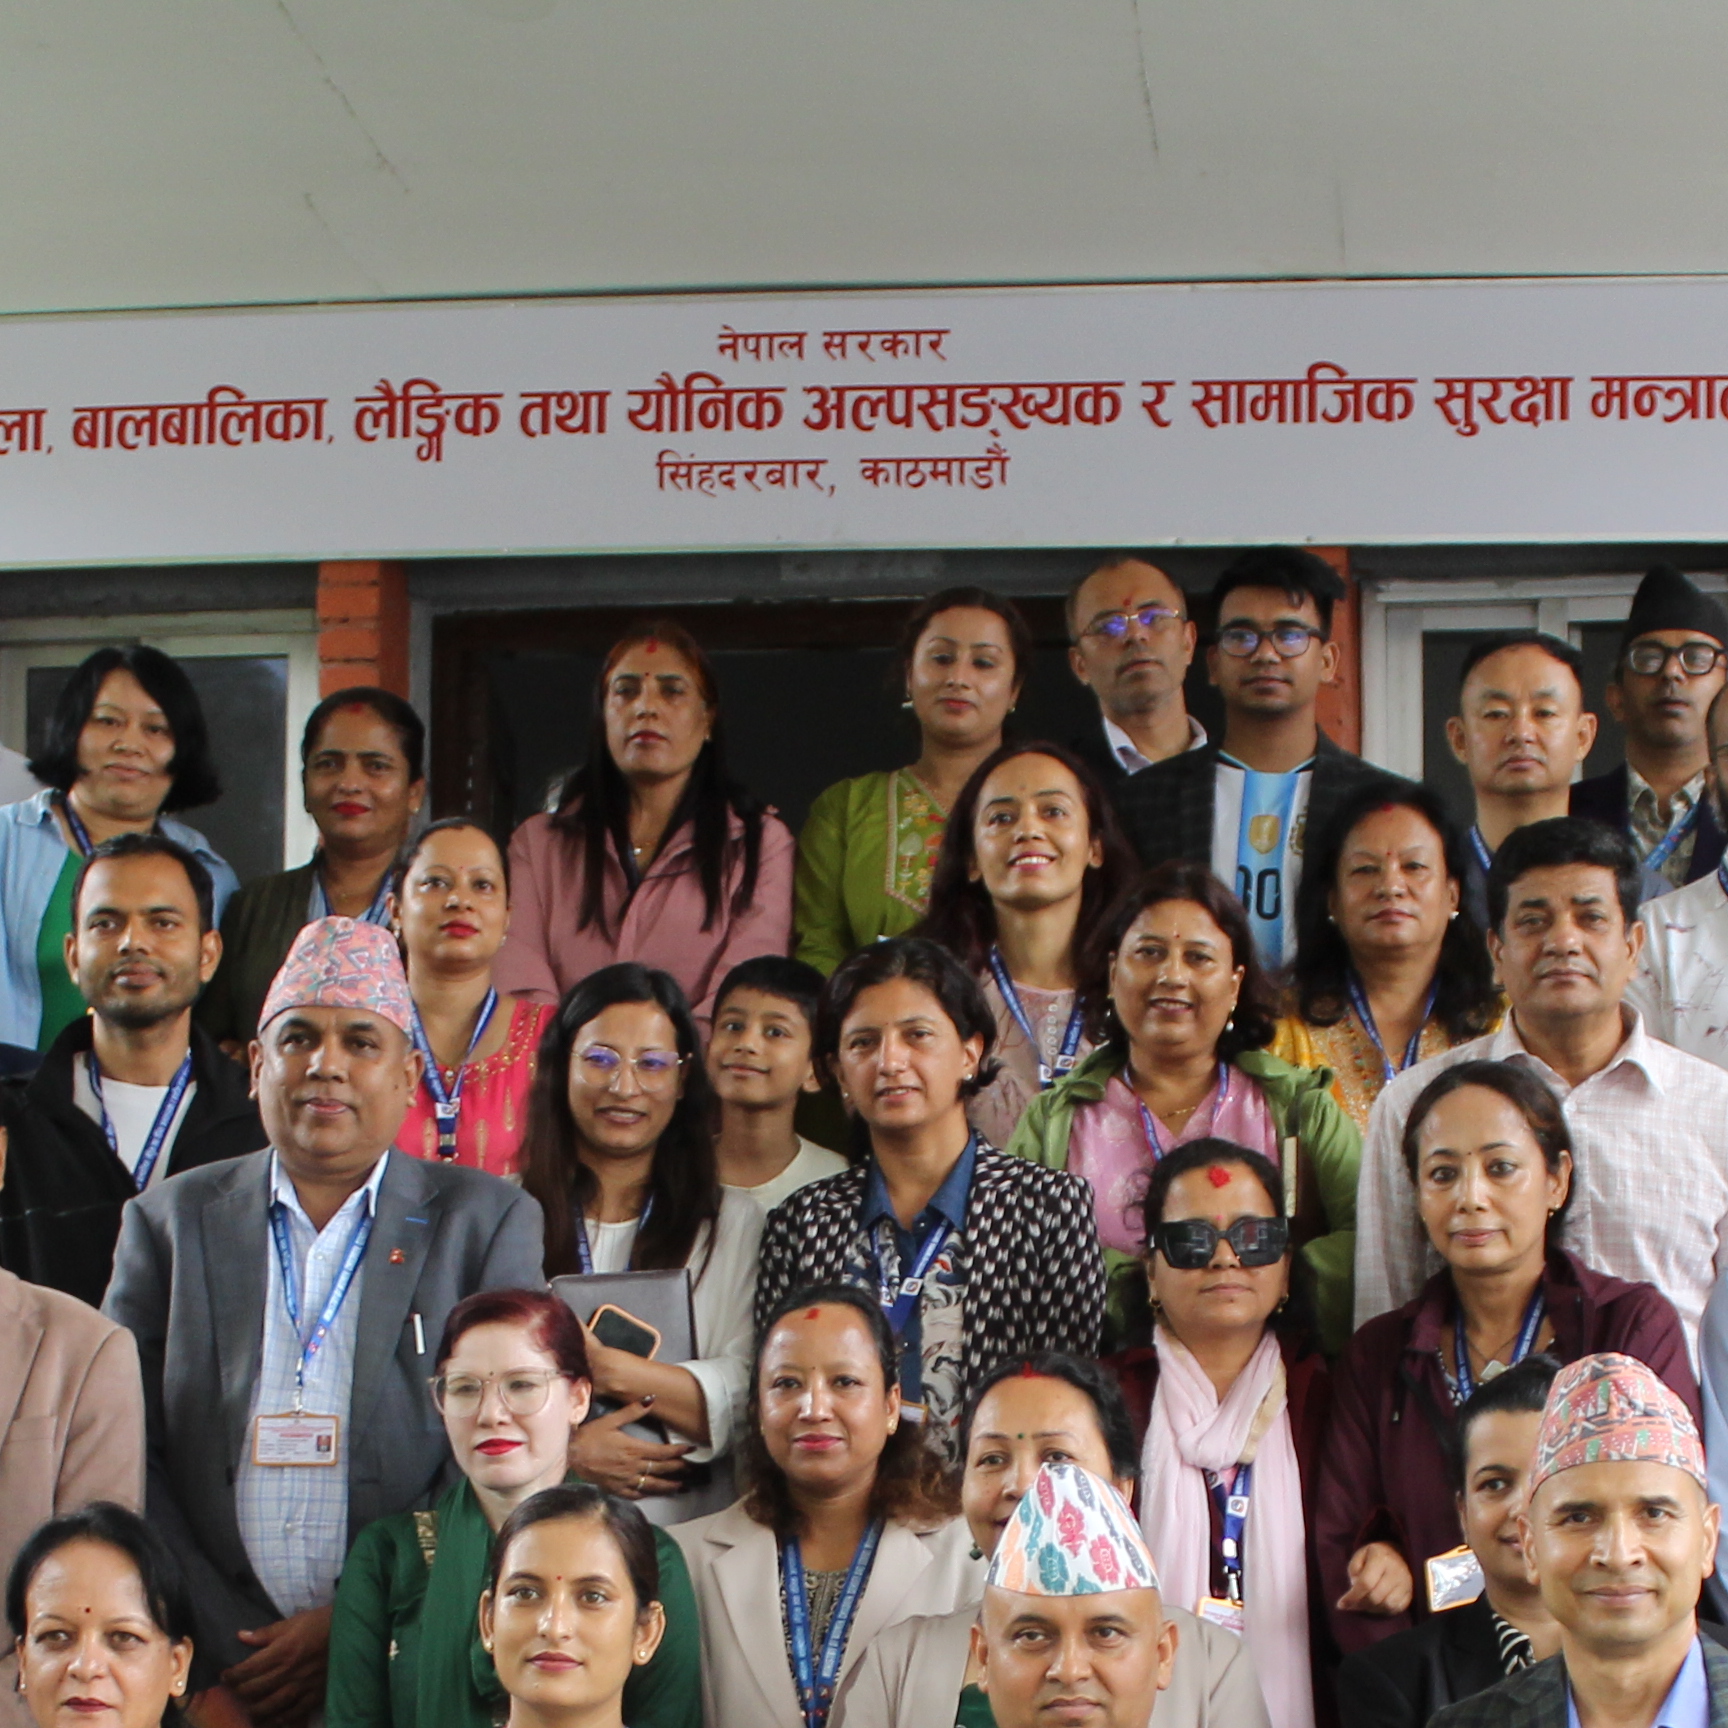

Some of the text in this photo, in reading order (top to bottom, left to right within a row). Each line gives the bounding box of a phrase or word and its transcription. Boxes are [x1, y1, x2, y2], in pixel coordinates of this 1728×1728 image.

[718, 325, 950, 361] नेपाल सरकार
[72, 385, 334, 452] बालबालिका,
[355, 378, 504, 462] लैङ्गिक
[519, 390, 611, 440] तथा
[627, 371, 787, 434] यौनिक
[1140, 381, 1175, 429] र
[1191, 361, 1418, 429] सामाजिक
[1434, 376, 1574, 437] सुरक्षा
[860, 443, 1011, 490] काठमाडौं
